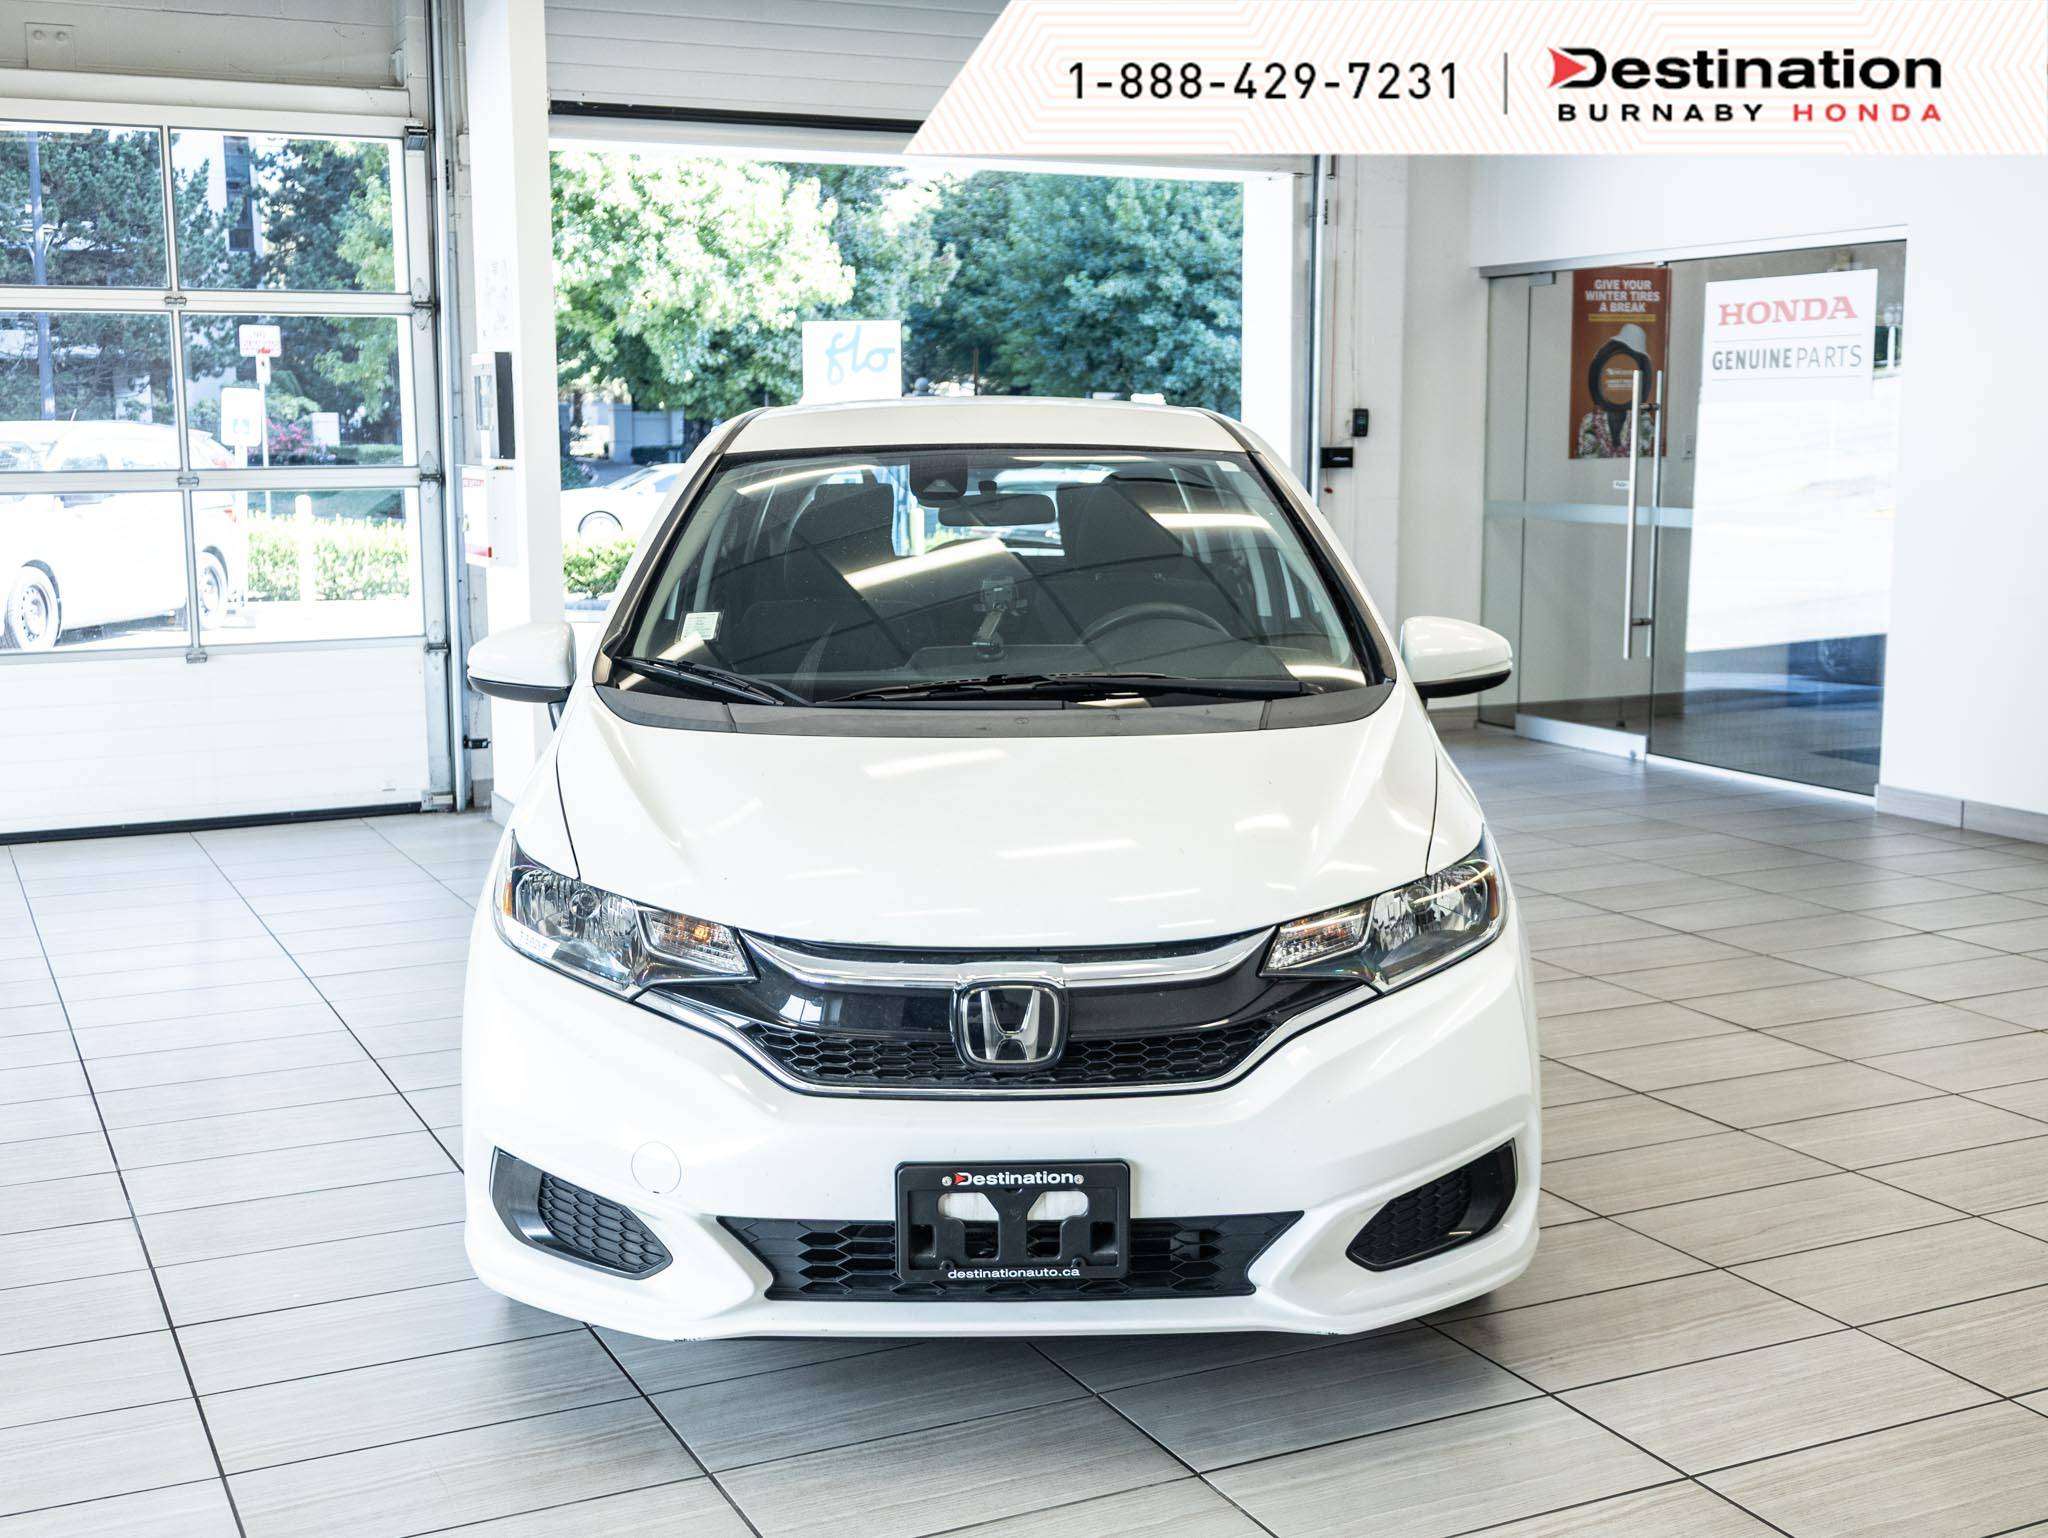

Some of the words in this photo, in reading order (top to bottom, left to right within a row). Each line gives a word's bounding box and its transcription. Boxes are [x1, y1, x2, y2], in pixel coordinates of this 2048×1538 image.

[1594, 279, 1620, 290] GIVE
[1623, 279, 1652, 290] YOUR
[1585, 290, 1628, 301] WINTER
[1630, 290, 1660, 302] TIRES
[1599, 302, 1608, 312] A
[1610, 302, 1646, 312] BREAK
[1718, 295, 1858, 326] HONDA
[825, 324, 895, 386] flo
[1712, 348, 1793, 370] GENUINE
[1796, 344, 1862, 369] PARTS
[947, 1267, 1080, 1279] destinationauto.ca
